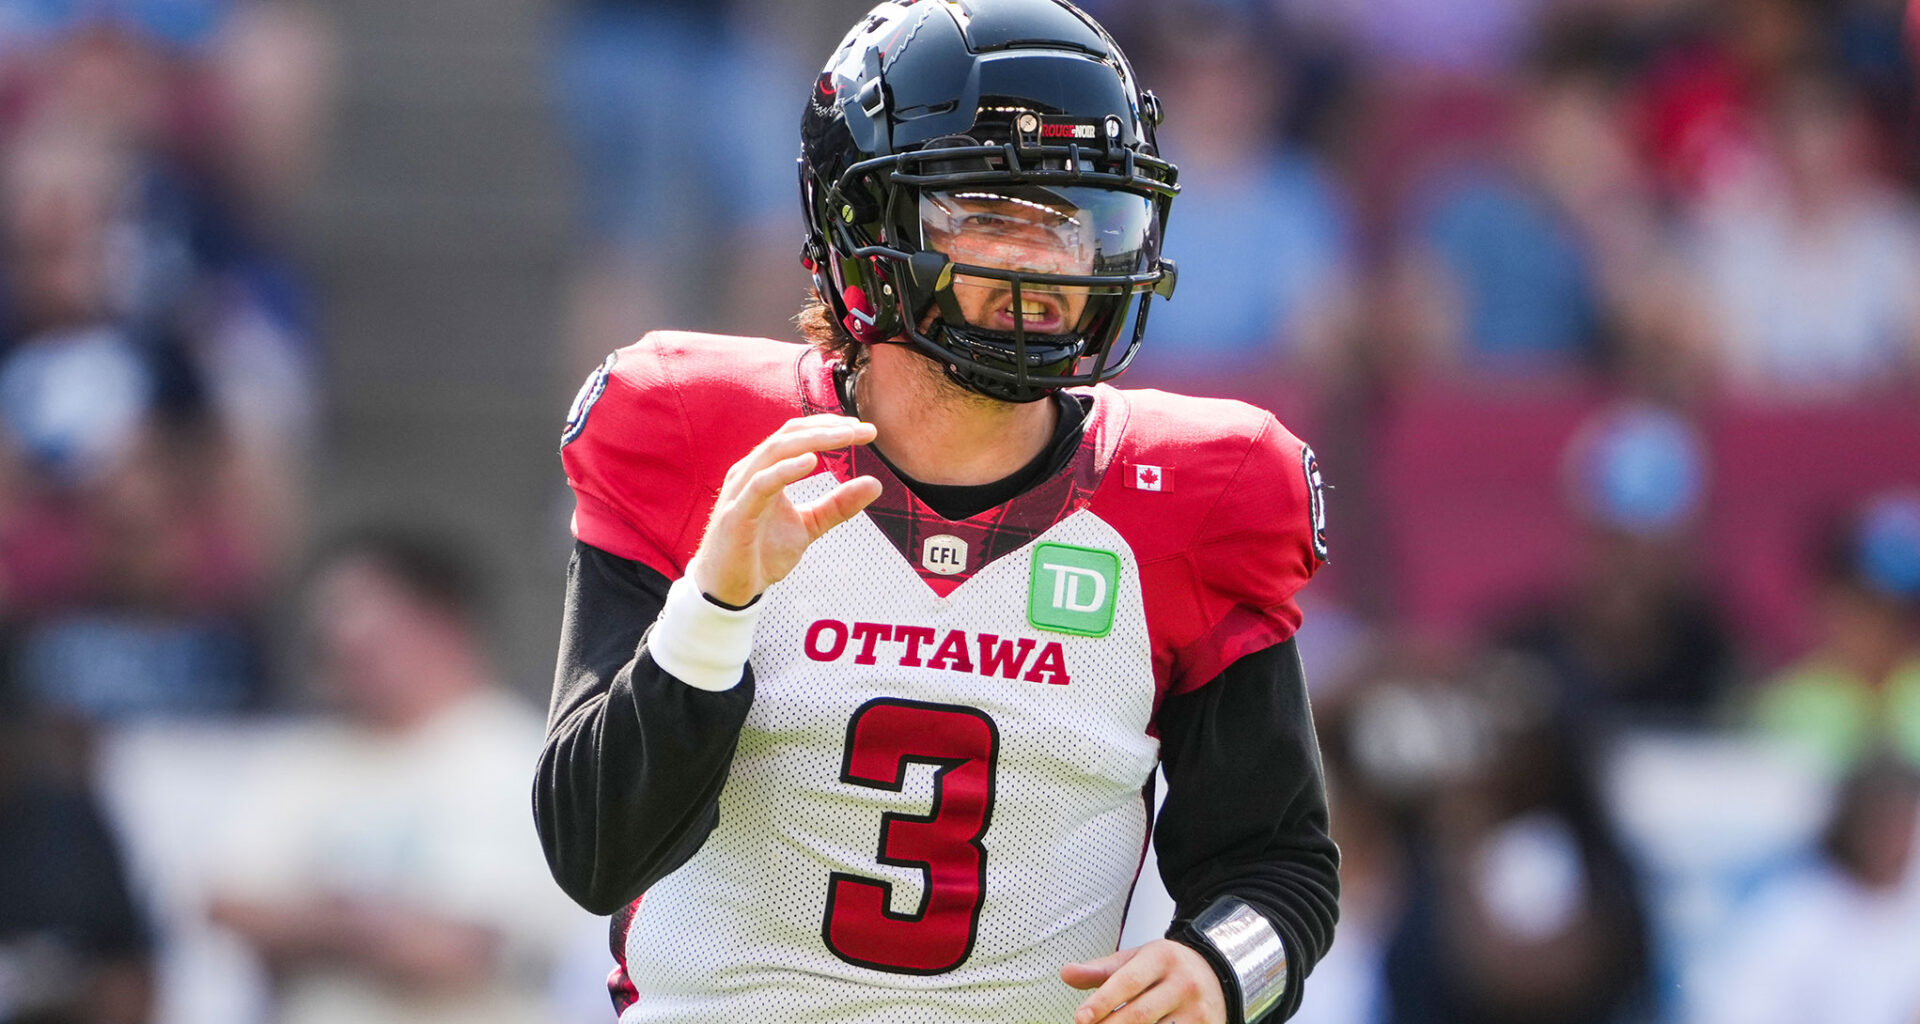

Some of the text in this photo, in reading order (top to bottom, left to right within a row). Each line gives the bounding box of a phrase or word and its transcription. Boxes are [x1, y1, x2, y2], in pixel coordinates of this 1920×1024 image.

[930, 546, 960, 565] CFL
[1043, 563, 1107, 613] TD
[804, 619, 1071, 685] OTTAWA
[822, 696, 1000, 976] 3
